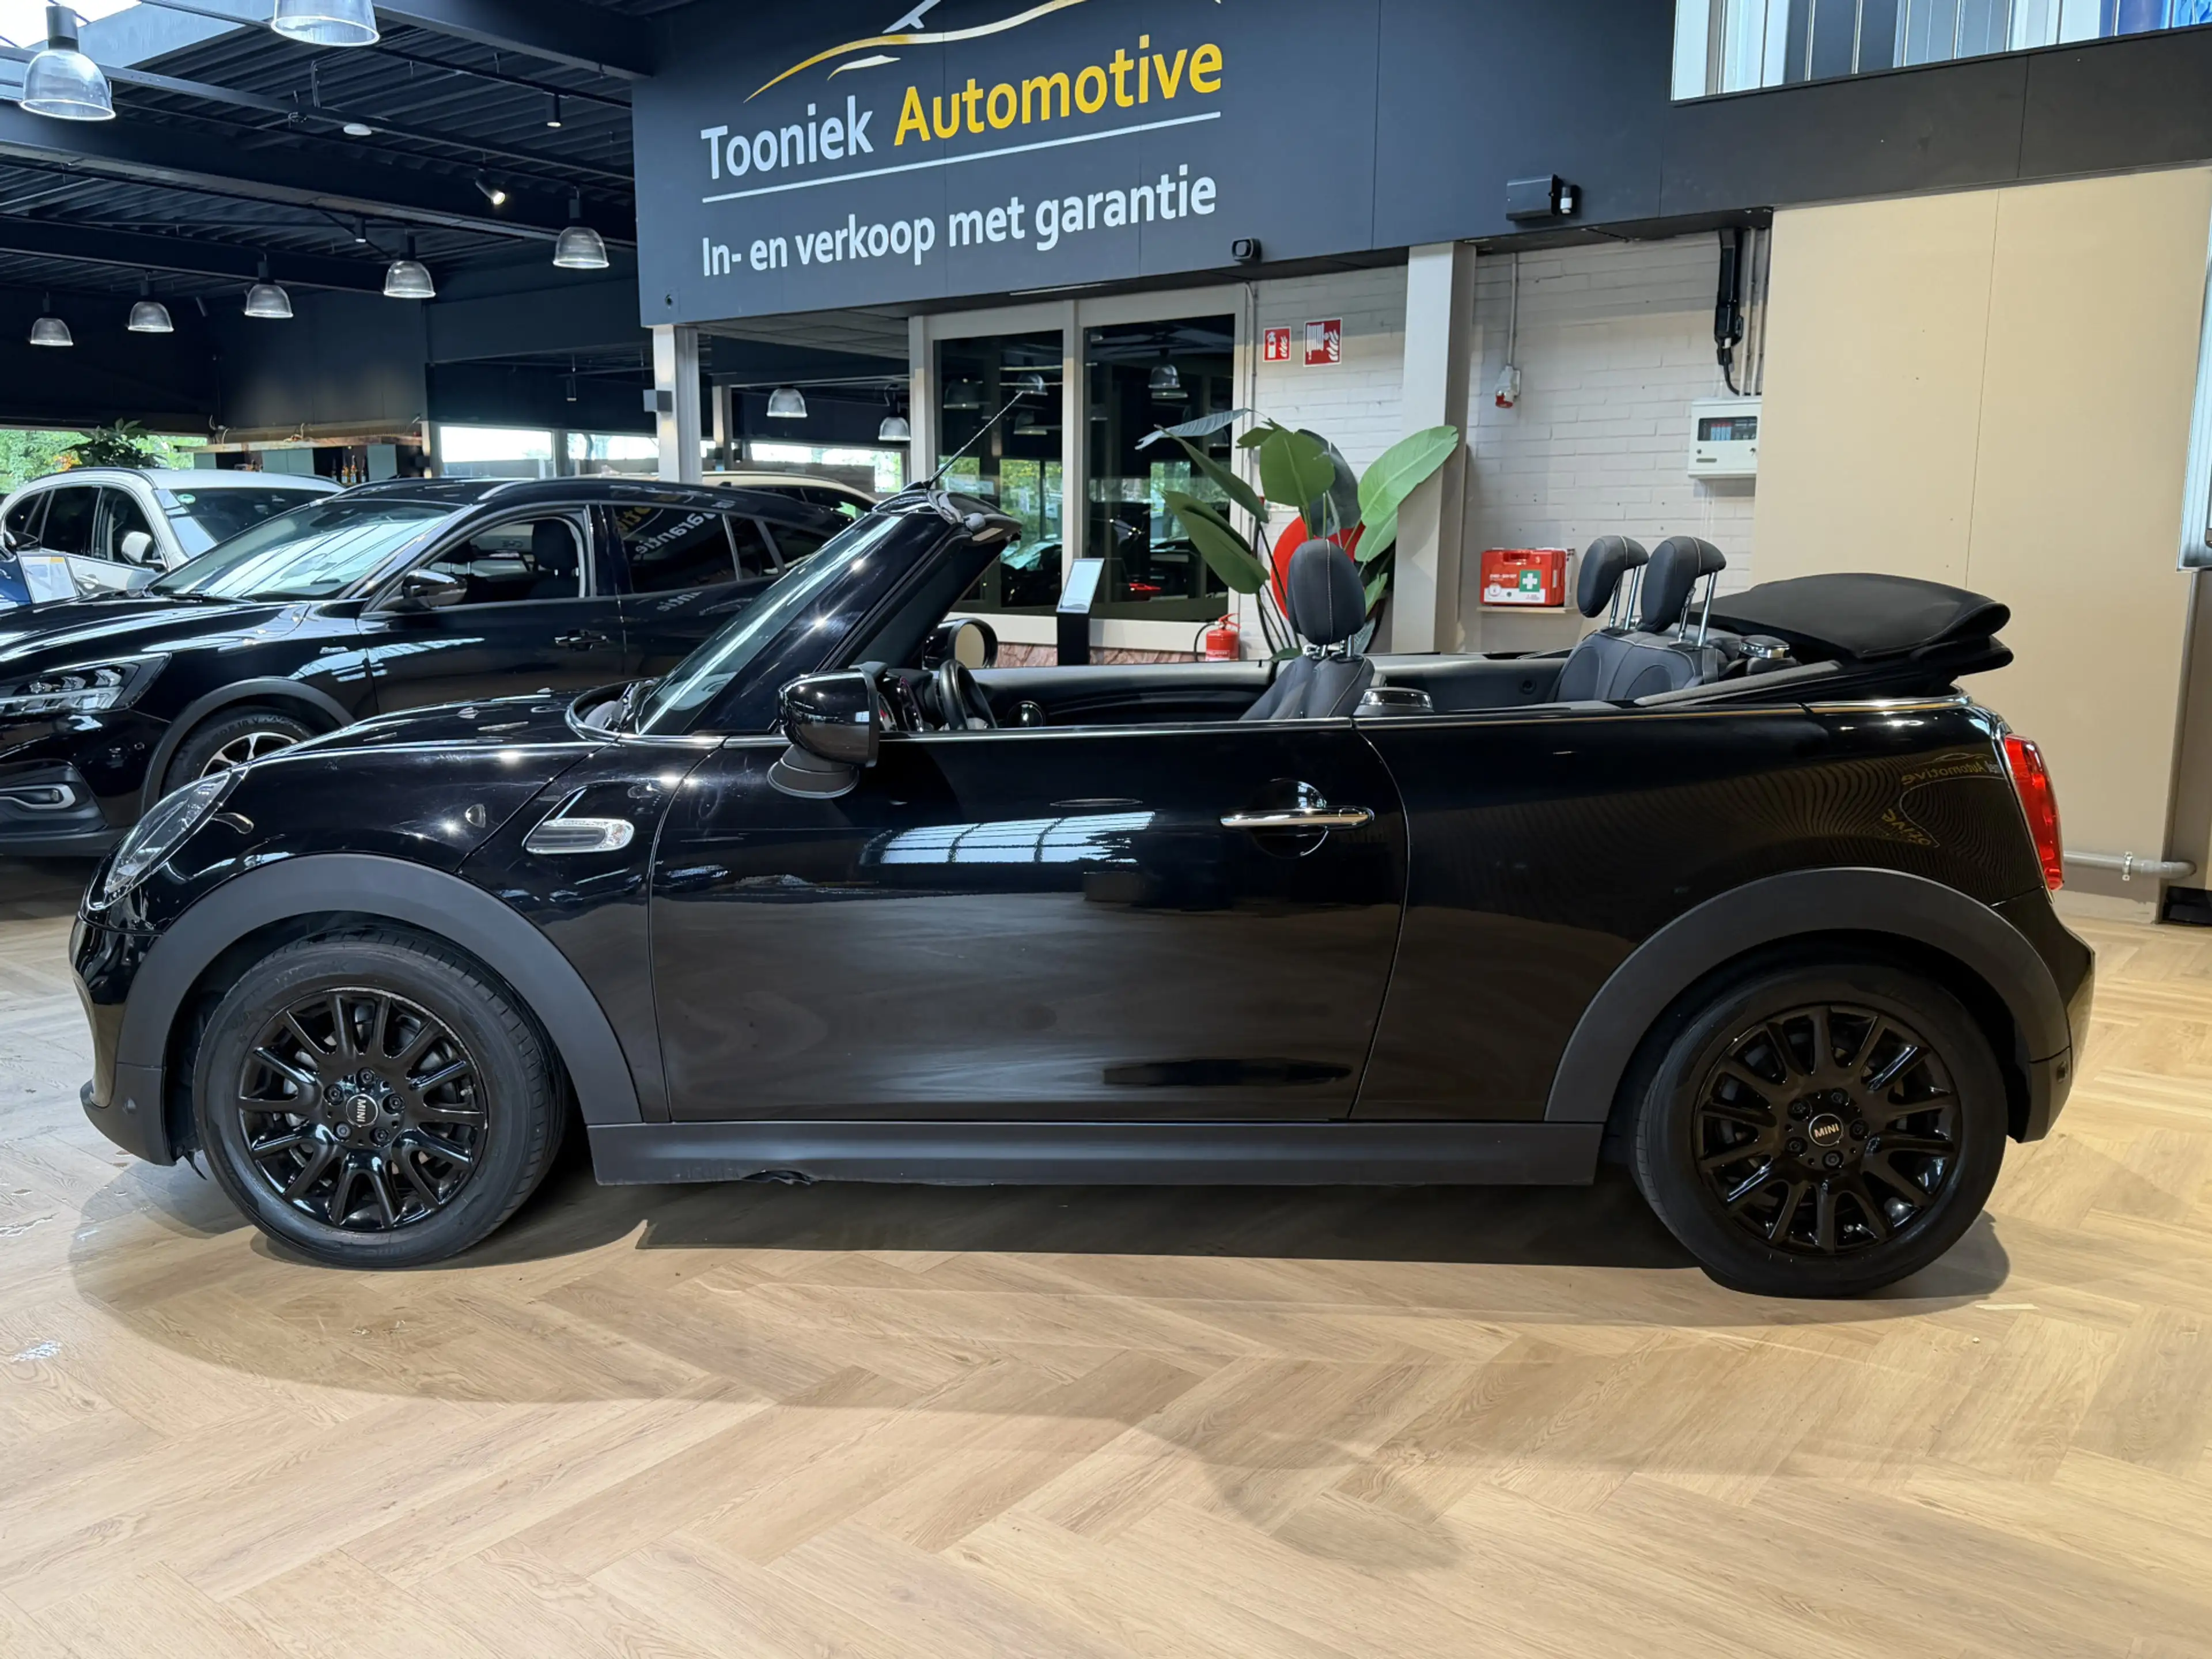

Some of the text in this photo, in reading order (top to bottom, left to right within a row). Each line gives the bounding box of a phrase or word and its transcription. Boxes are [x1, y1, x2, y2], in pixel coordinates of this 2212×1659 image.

[700, 35, 1222, 179] Tooniek Automotive
[702, 164, 1217, 277] In- en verkoop met garantie
[357, 1099, 366, 1122] MINI
[1814, 1123, 1839, 1138] MINI
